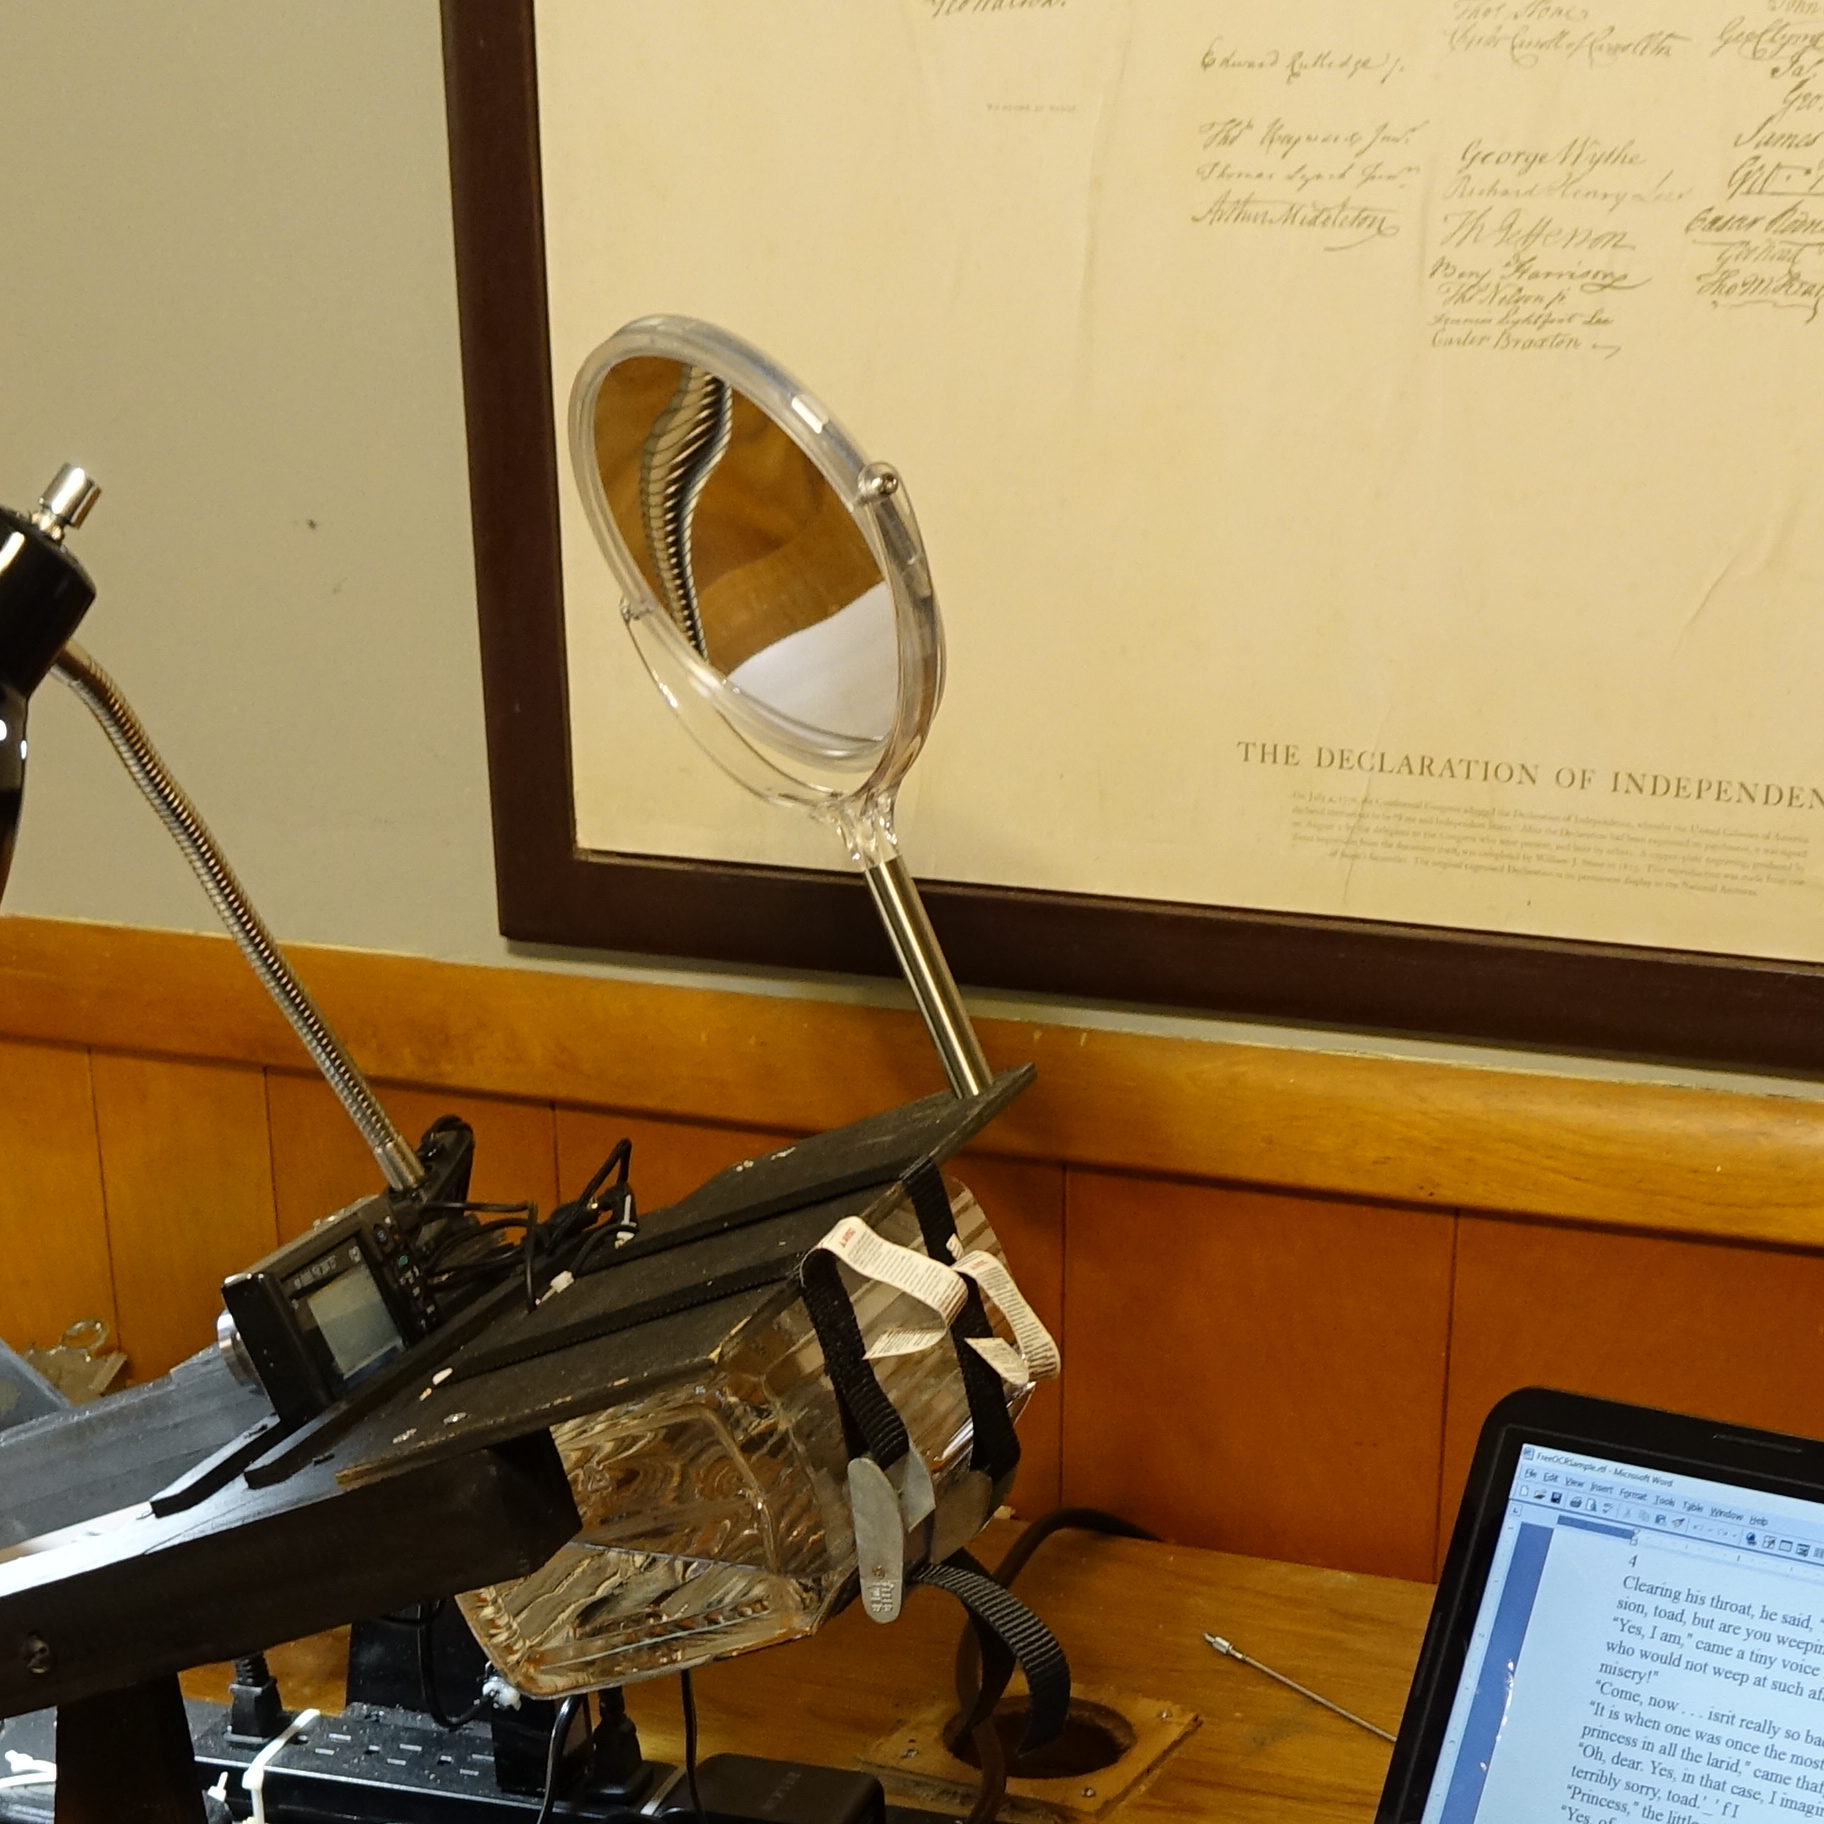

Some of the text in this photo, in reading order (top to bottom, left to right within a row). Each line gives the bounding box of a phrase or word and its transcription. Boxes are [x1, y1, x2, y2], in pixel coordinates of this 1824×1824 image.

[1458, 136, 1646, 176] George Wythe
[1734, 115, 1818, 150] James
[1494, 208, 1635, 254] Jefferson
[1494, 329, 1581, 351] Braxton
[1236, 741, 1300, 767] THE
[1316, 746, 1539, 786] DECLARATION
[1555, 767, 1596, 791] OF
[1543, 1472, 1558, 1483] Edit
[1565, 1477, 1584, 1488] View
[1590, 1482, 1613, 1494] Insert
[1620, 1487, 1647, 1502] Format
[1655, 1495, 1675, 1507] Tools
[1683, 1500, 1704, 1512] Table
[1709, 1506, 1744, 1522] Window
[1750, 1515, 1768, 1527] Help
[1613, 1467, 1649, 1484] Microsoft
[1652, 1475, 1673, 1488] Word
[1615, 1595, 1648, 1618] sion,
[1652, 1603, 1687, 1627] toad,
[1690, 1610, 1715, 1631] but
[1717, 1621, 1742, 1636] are
[1741, 1627, 1773, 1643] you
[1622, 1574, 1683, 1604] Clearing
[1683, 1587, 1707, 1606] his
[1708, 1593, 1755, 1620] throat,
[1758, 1603, 1779, 1622] he
[1779, 1612, 1814, 1633] said,
[1605, 1639, 1636, 1657] who
[1638, 1648, 1684, 1668] would
[1683, 1659, 1709, 1675] not
[1711, 1665, 1750, 1687] weep
[1751, 1674, 1769, 1689] at
[1769, 1679, 1804, 1697] such
[1694, 1639, 1734, 1657] came
[1748, 1647, 1778, 1670] tiny
[1781, 1657, 1821, 1677] voice
[1606, 1704, 1621, 1721] is
[1623, 1710, 1661, 1731] when
[1663, 1722, 1691, 1738] one
[1694, 1729, 1723, 1746] was
[1724, 1737, 1761, 1755] once
[1762, 1742, 1788, 1762] the
[1646, 1695, 1680, 1712] now
[1737, 1717, 1782, 1740] really
[1783, 1728, 1801, 1742] so
[1579, 1723, 1639, 1748] princess
[1640, 1735, 1655, 1753] in
[1657, 1741, 1679, 1758] all
[1679, 1745, 1704, 1764] the
[1752, 1767, 1793, 1786] came
[1610, 1750, 1644, 1772] dear.
[1649, 1759, 1677, 1783] Yes,
[1680, 1767, 1696, 1785] in
[1698, 1772, 1728, 1793] that
[1729, 1784, 1765, 1805] case,
[1640, 1803, 1665, 1823] the
